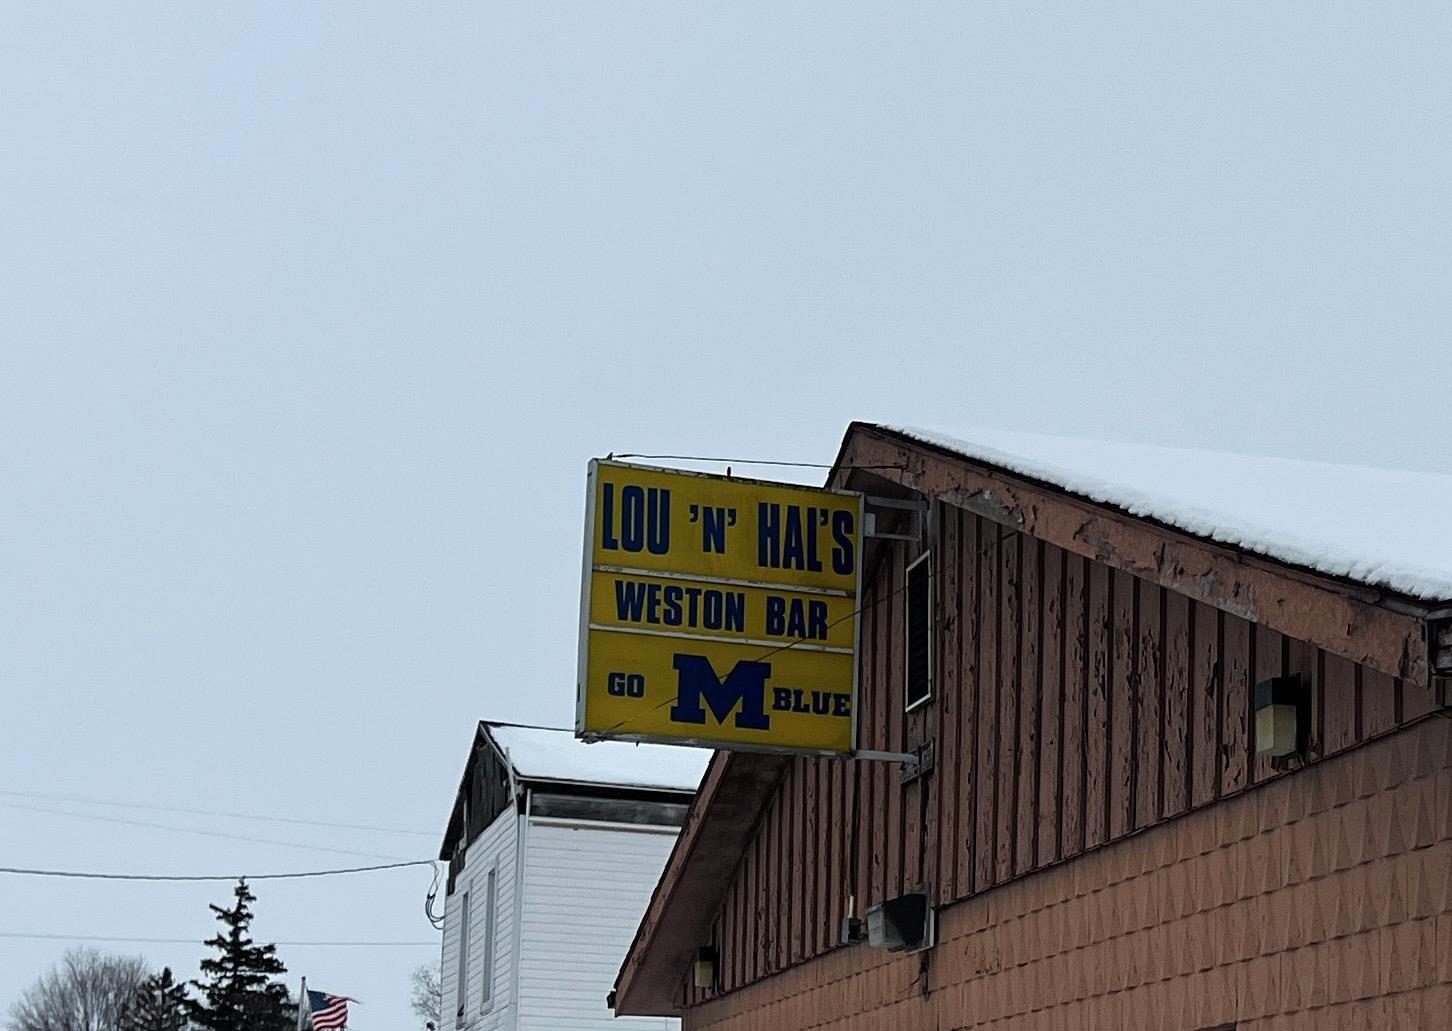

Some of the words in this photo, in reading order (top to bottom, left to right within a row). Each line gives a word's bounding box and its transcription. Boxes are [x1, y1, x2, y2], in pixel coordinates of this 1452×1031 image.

[603, 482, 671, 555] LOU
[758, 502, 854, 575] HAL'S
[615, 580, 745, 632] WESTON
[766, 596, 828, 640] BAR
[608, 672, 645, 698] GO
[670, 652, 772, 730] M
[772, 687, 852, 718] BLUE
